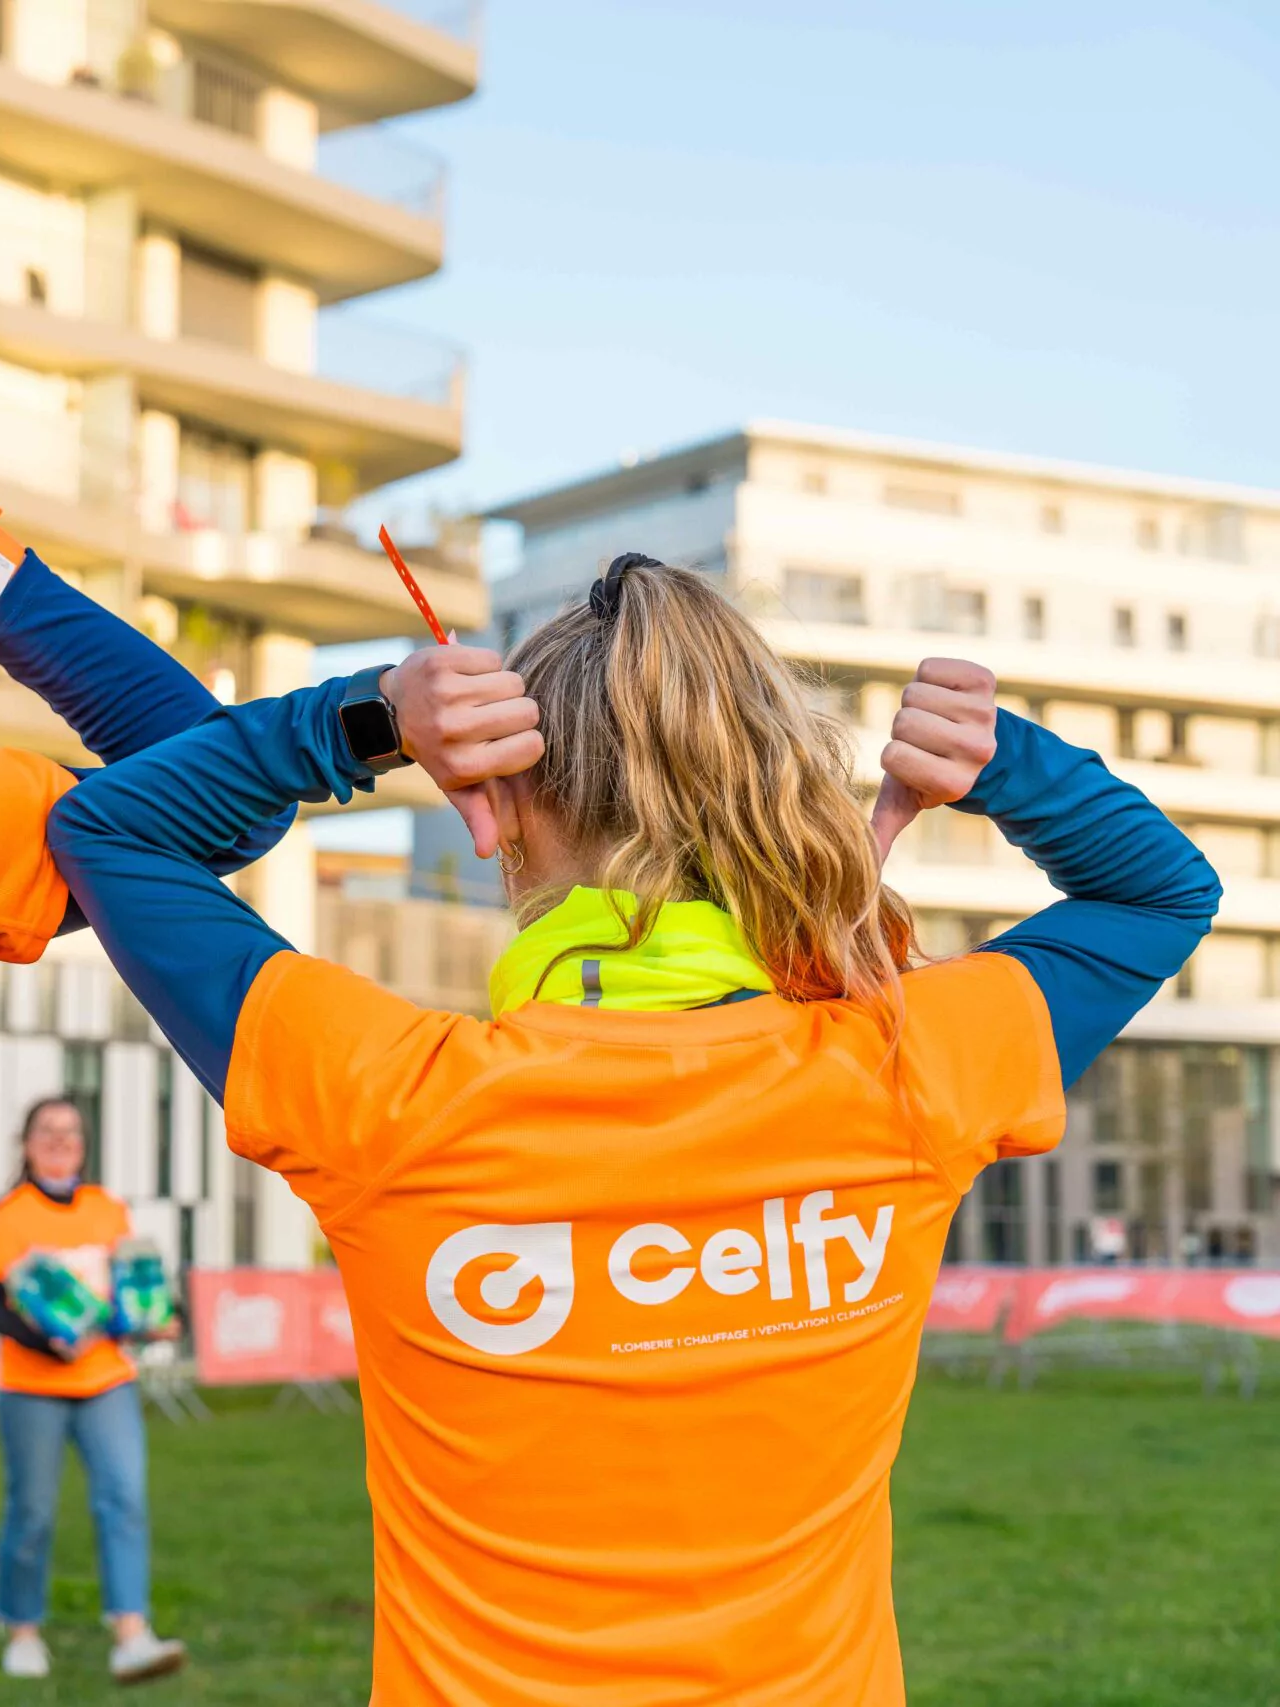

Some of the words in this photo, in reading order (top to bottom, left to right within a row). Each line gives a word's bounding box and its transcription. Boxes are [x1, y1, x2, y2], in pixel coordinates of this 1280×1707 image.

[611, 1338, 674, 1354] PLOMBERIE
[683, 1329, 749, 1347] CHAUFFAGE
[758, 1315, 829, 1336] VENTILATION
[836, 1291, 904, 1322] CLIMATISATION
